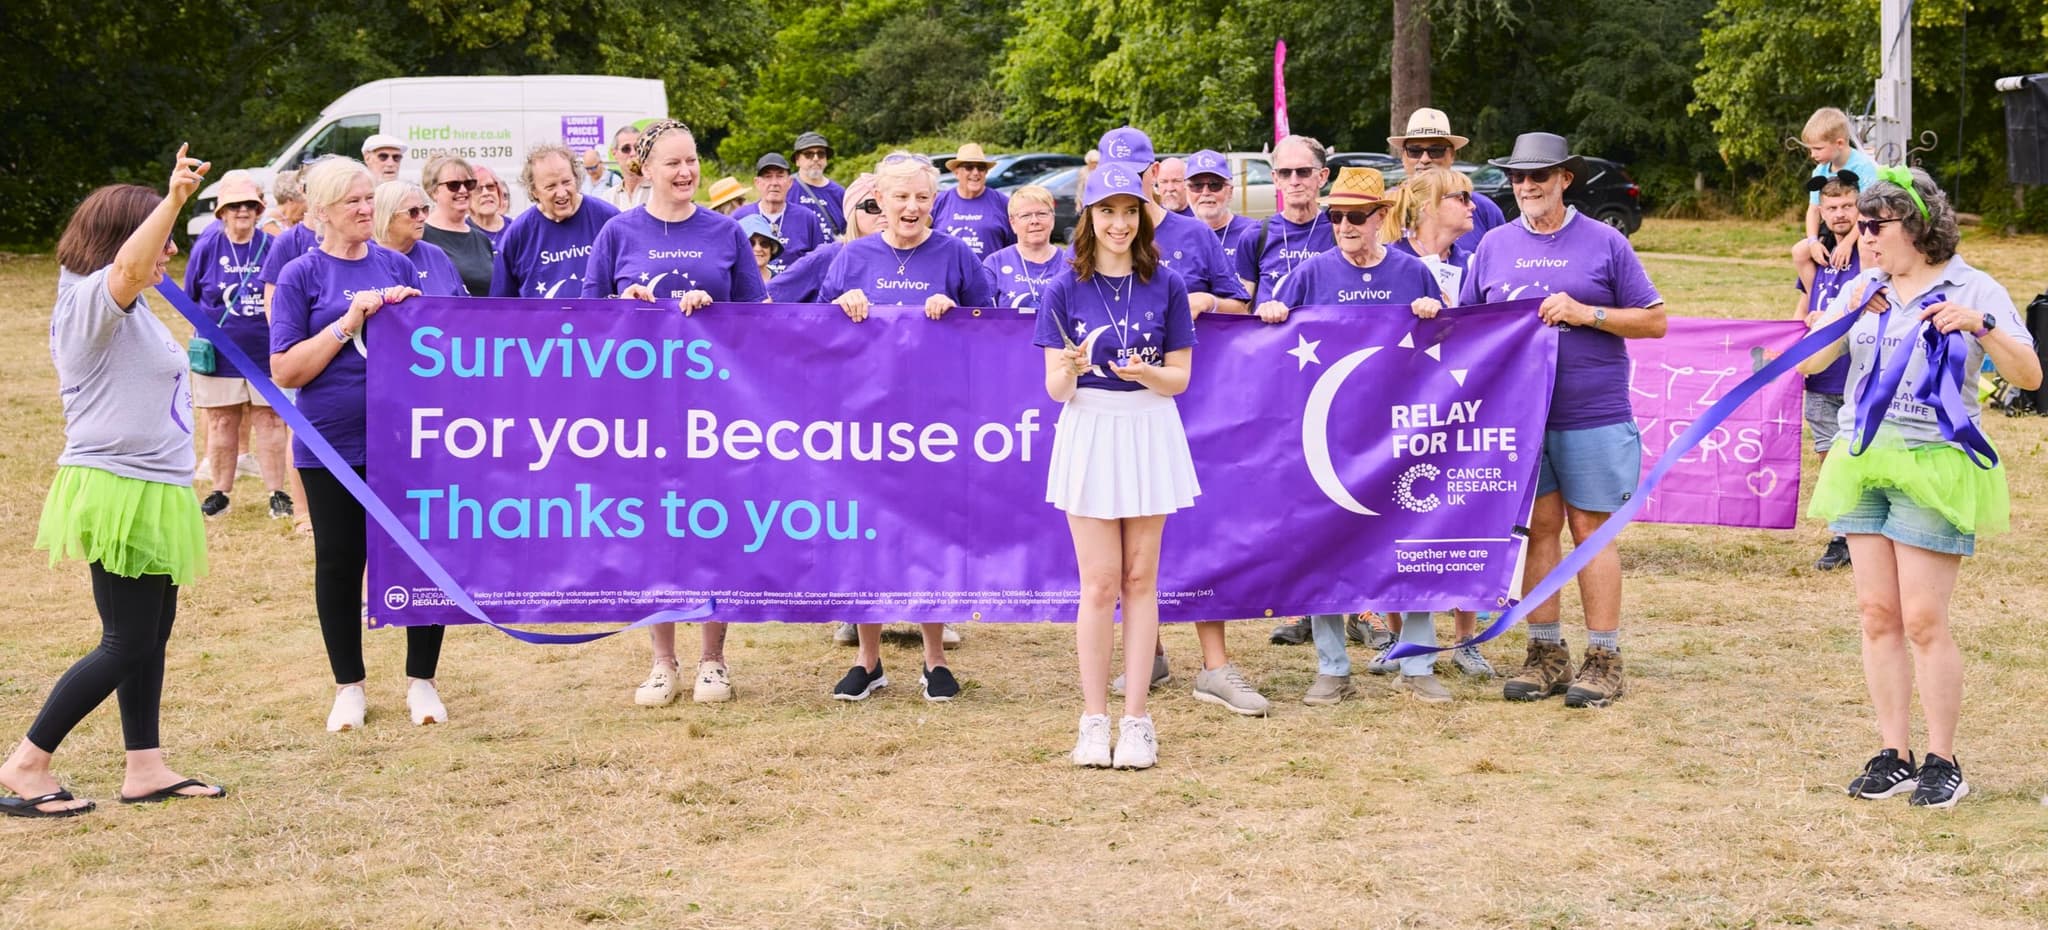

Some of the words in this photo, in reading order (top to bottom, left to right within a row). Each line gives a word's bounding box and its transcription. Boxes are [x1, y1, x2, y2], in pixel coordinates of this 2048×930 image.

[409, 126, 450, 140] Herd
[453, 128, 511, 139] hire.co.uk
[481, 147, 512, 158] 3378
[540, 244, 592, 264] Survivo
[649, 249, 704, 259] Survivor
[1279, 248, 1321, 259] Survivo
[1514, 256, 1568, 268] Survivor
[876, 278, 930, 291] Survivor
[1338, 288, 1392, 303] Survivor
[408, 322, 730, 380] Survivors.
[1392, 399, 1483, 429] RELAY
[1904, 402, 1929, 417] LIFE
[410, 407, 515, 459] For
[528, 423, 666, 471] you.
[686, 408, 959, 463] Because
[973, 408, 1040, 463] of
[1392, 431, 1448, 459] FOR
[1456, 427, 1517, 452] LIFE
[1446, 468, 1502, 480] CANCER
[1447, 480, 1518, 492] RESEARCH
[1447, 494, 1466, 505] UK
[406, 483, 646, 540] Thanks
[660, 488, 729, 540] to
[743, 496, 877, 553] you.
[1395, 548, 1448, 561] Together
[1450, 550, 1466, 559] we
[1468, 550, 1488, 559] are
[1397, 562, 1444, 574] beating
[1445, 562, 1485, 572] cancer
[388, 594, 405, 603] FR
[523, 590, 555, 598] organised
